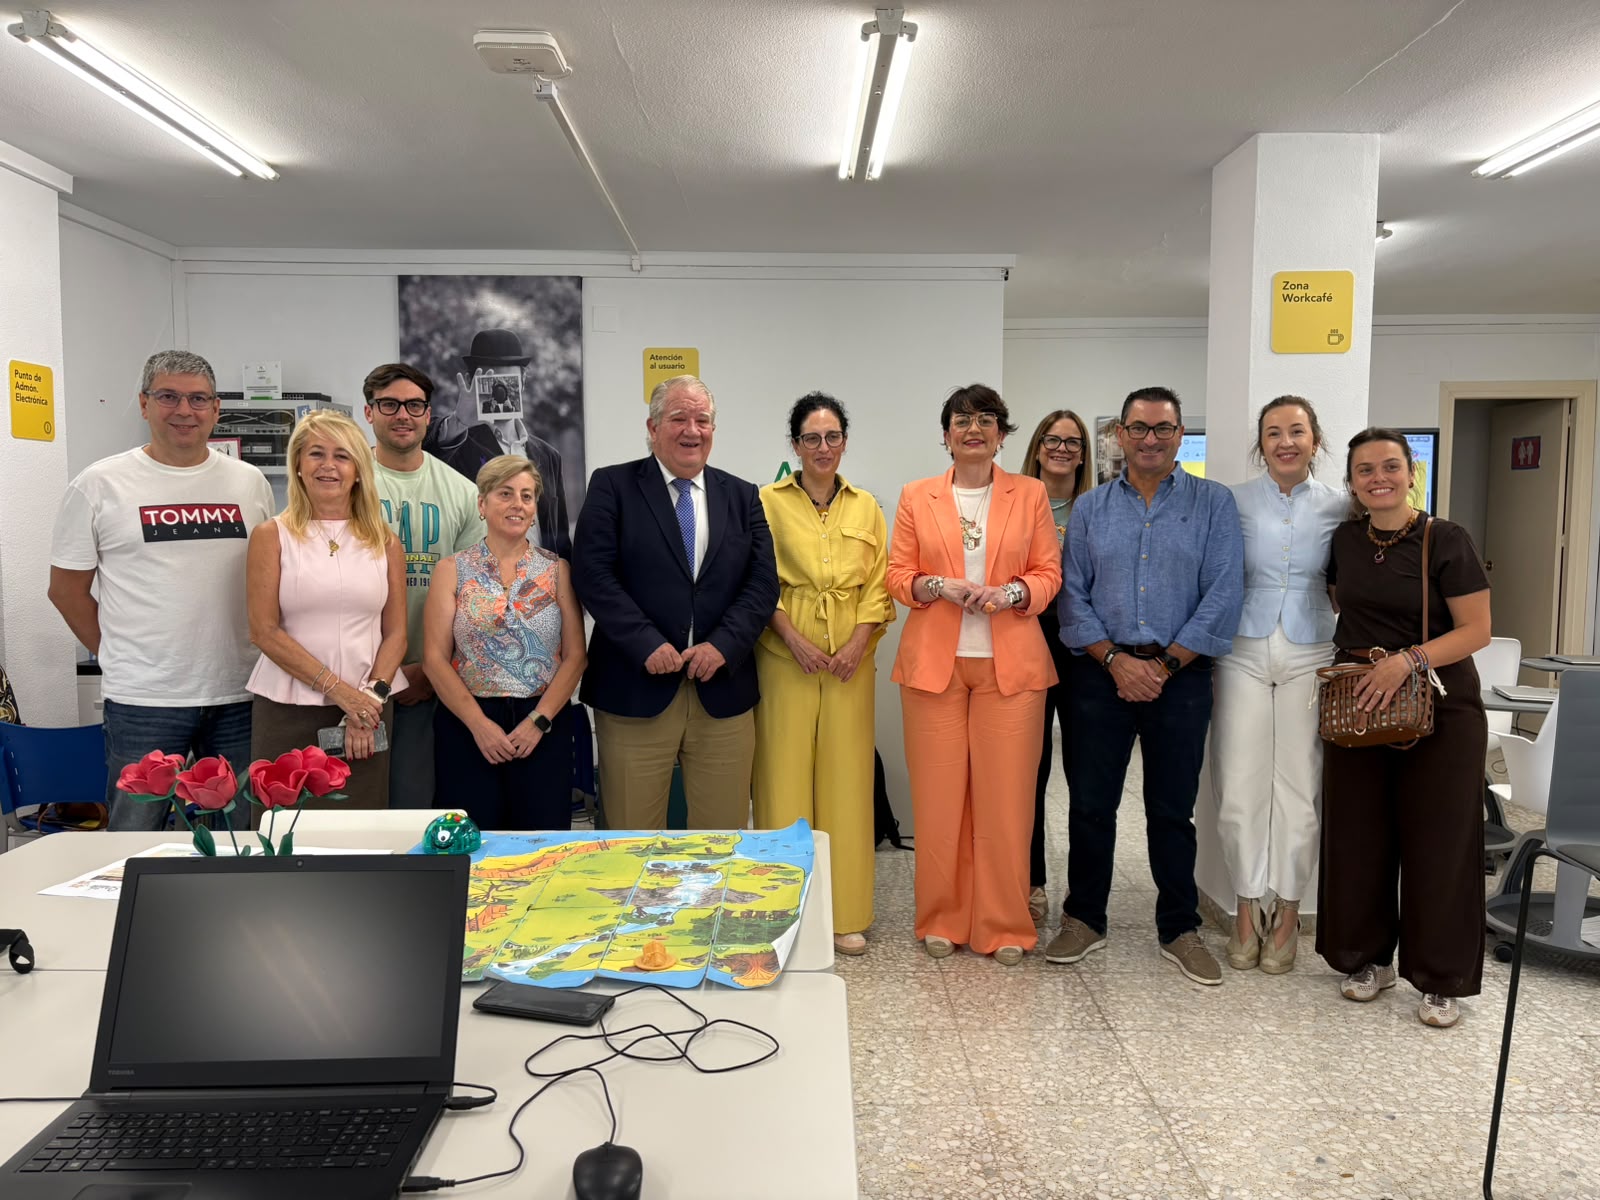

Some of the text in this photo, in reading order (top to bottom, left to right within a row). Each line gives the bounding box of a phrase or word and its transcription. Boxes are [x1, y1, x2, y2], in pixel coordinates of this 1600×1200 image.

[1282, 280, 1309, 290] Zona
[1282, 292, 1333, 302] Workcafé
[649, 362, 686, 370] al usuario
[14, 369, 42, 383] Punto de
[15, 381, 39, 393] Admón.
[15, 392, 49, 406] Electrónica
[144, 508, 237, 526] TOMMY
[153, 526, 240, 536] JEANS
[379, 499, 440, 574] AP
